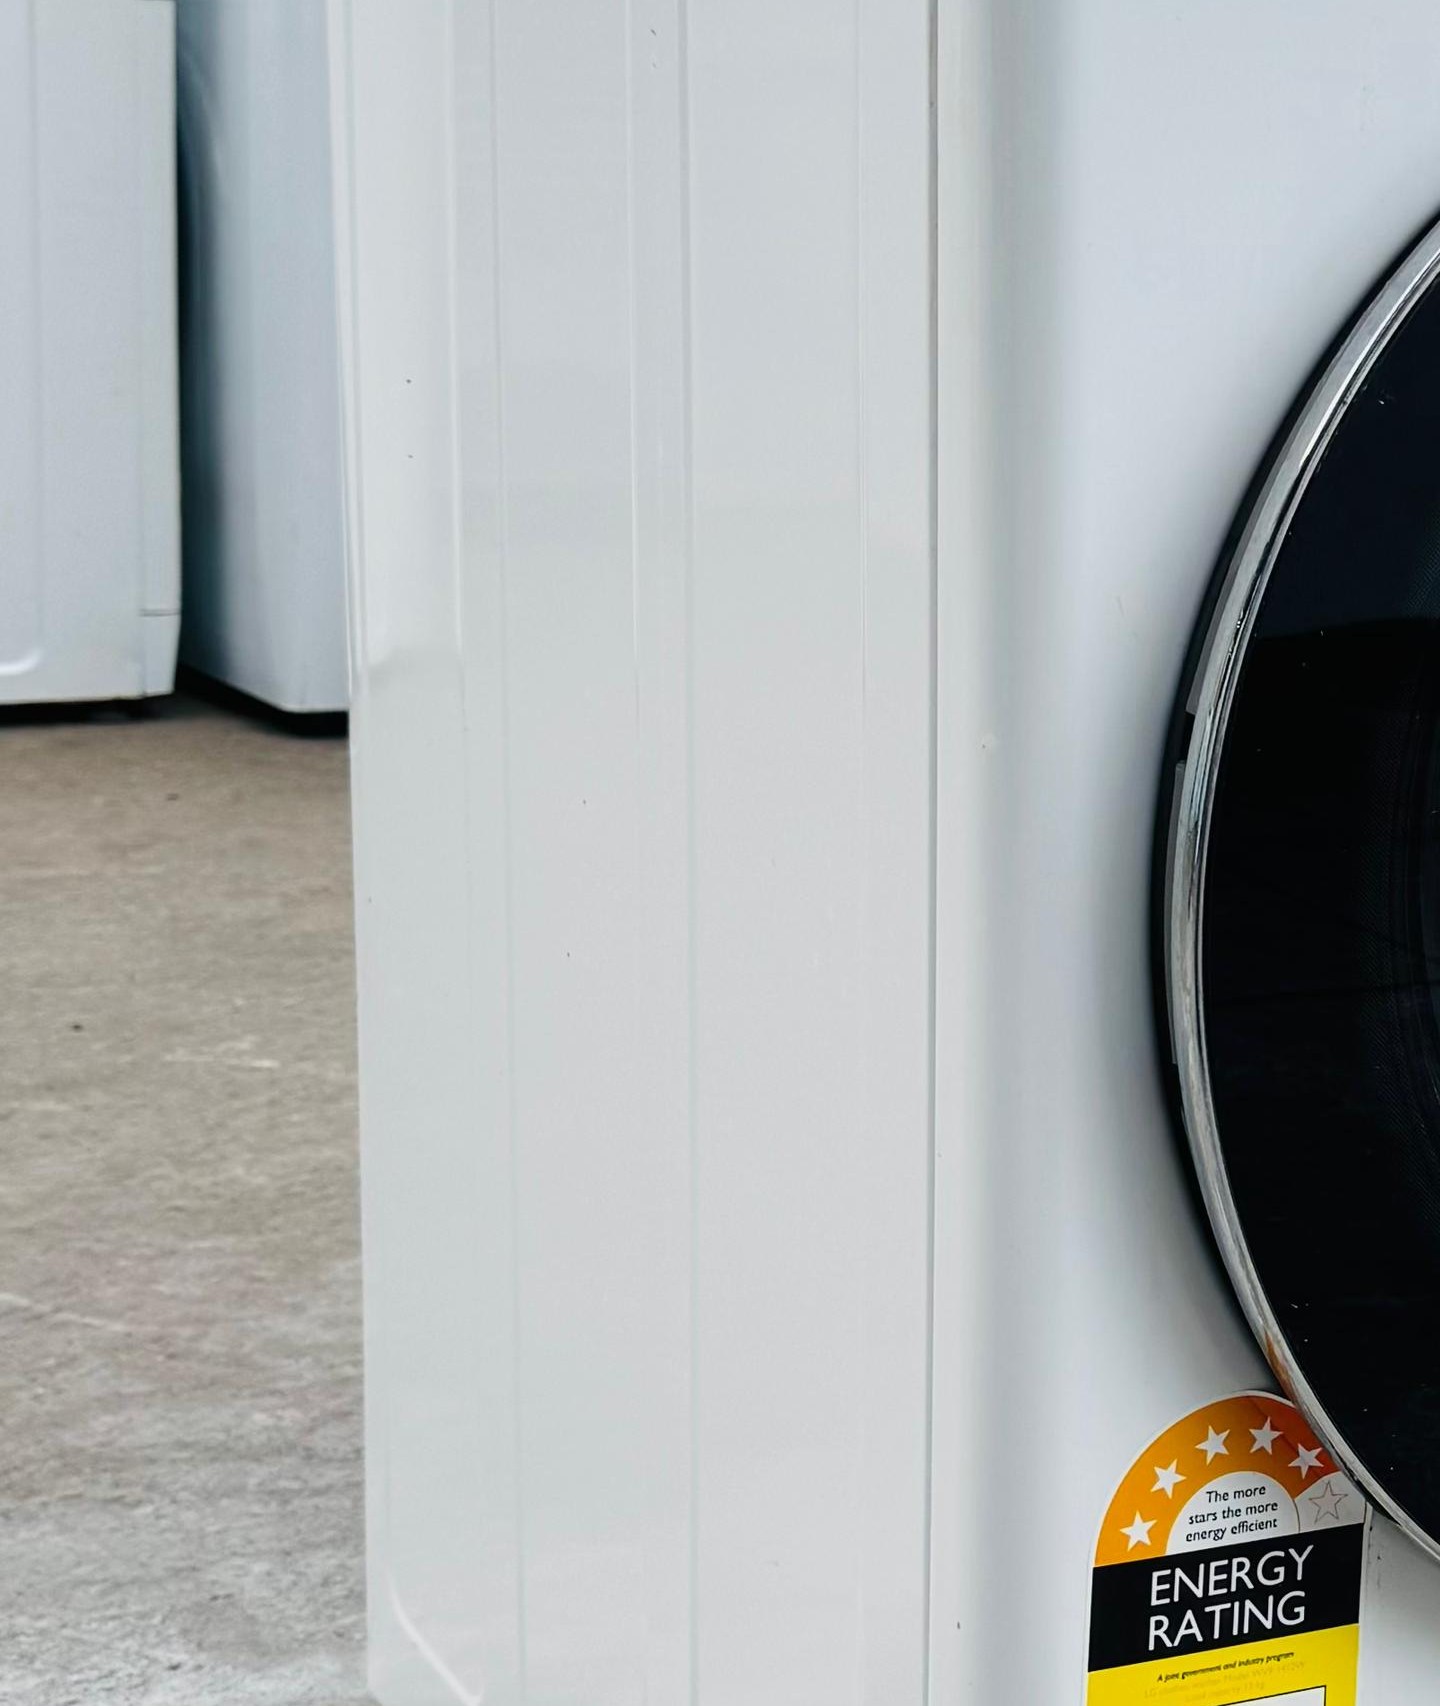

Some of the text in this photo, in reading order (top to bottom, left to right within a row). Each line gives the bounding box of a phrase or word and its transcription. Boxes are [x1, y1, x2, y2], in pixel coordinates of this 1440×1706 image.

[1205, 1486, 1267, 1503] The more
[1188, 1502, 1278, 1525] stars the more
[1185, 1518, 1278, 1542] energy efficient
[1150, 1544, 1315, 1606] ENERGY
[1148, 1590, 1306, 1651] RATING
